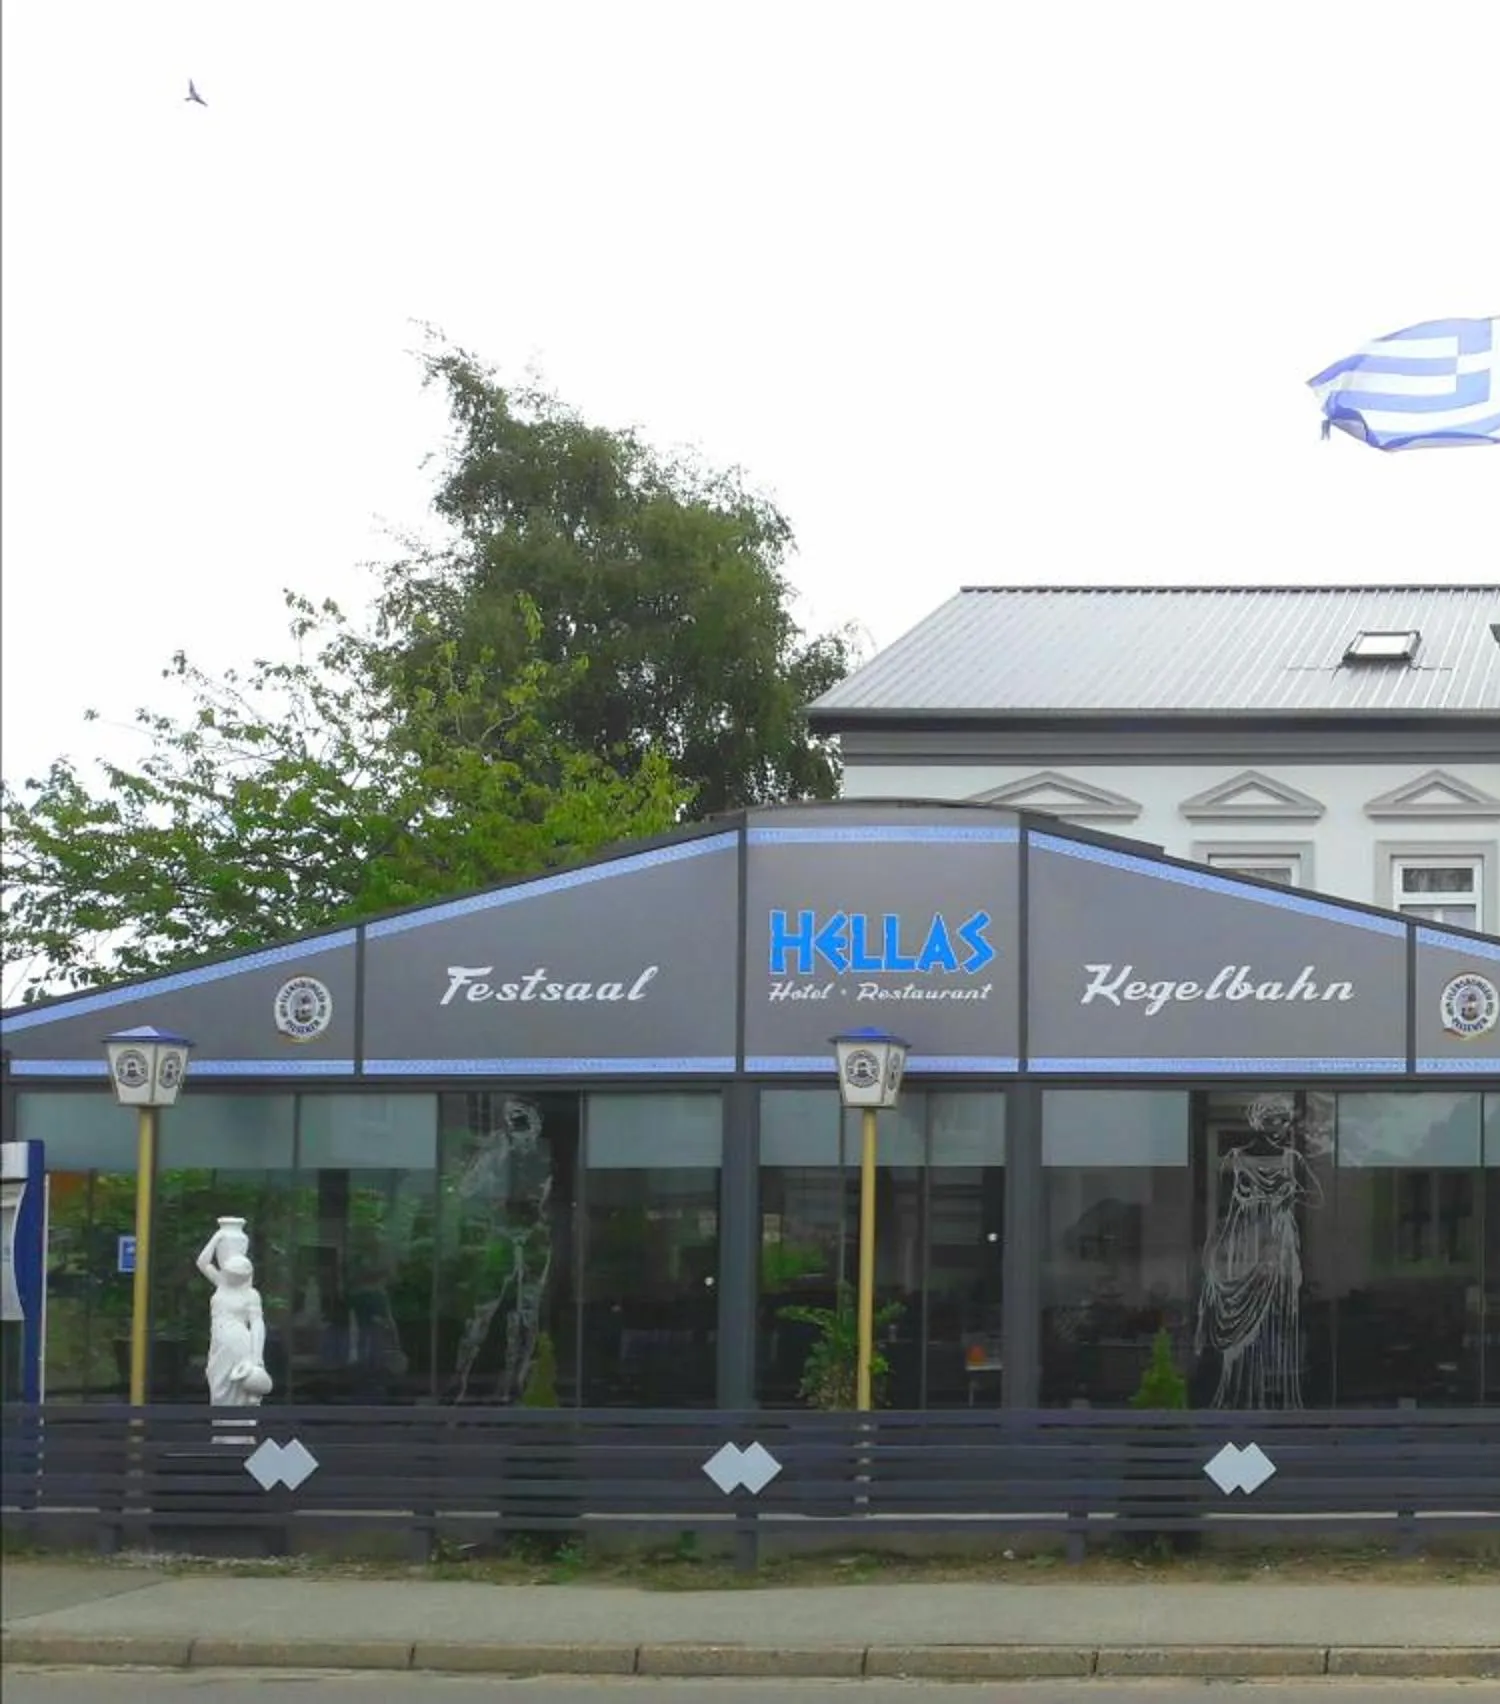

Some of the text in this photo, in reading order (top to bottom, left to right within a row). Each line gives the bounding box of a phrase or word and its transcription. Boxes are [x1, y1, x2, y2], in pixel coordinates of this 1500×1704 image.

[768, 909, 996, 975] HELLAS
[439, 965, 660, 1005] Festsaal
[768, 981, 993, 1002] Hotel Restaurant
[1080, 963, 1354, 1016] Kegelbahn
